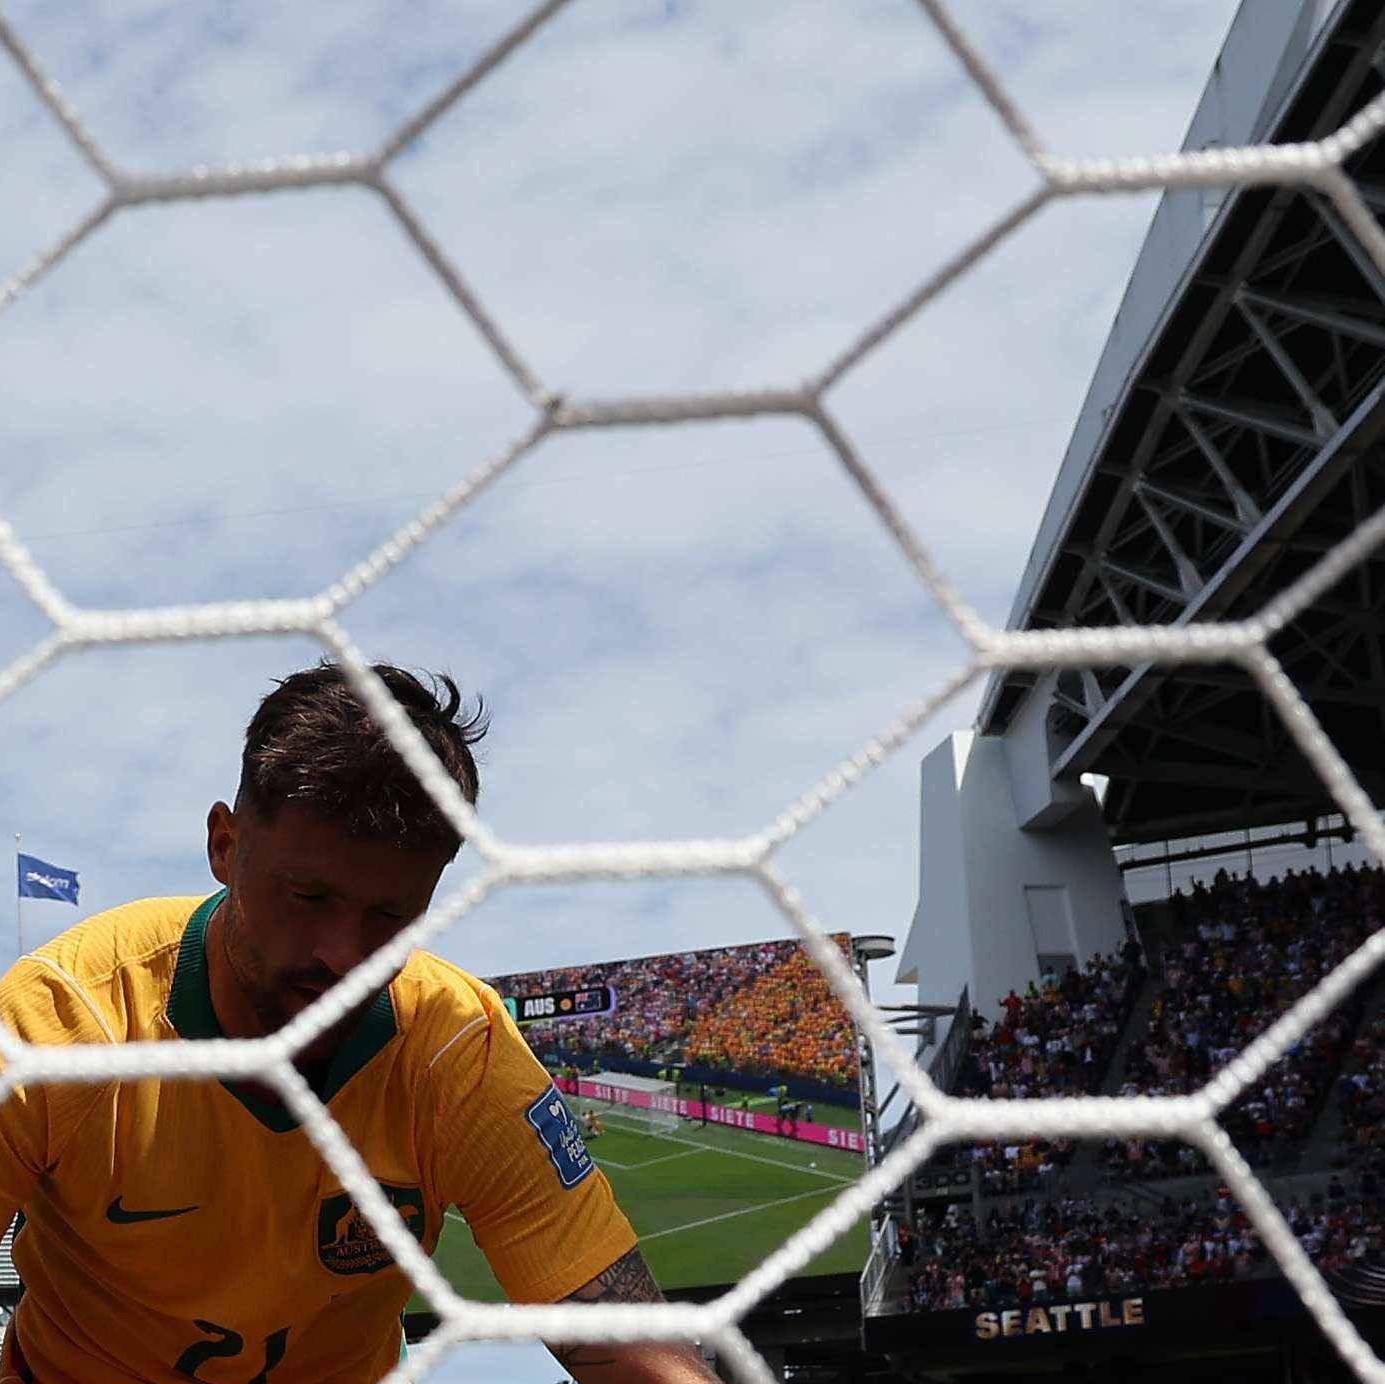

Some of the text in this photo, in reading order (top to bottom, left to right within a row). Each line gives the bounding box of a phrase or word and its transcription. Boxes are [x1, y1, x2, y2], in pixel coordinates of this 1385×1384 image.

[524, 997, 556, 1017] AUS
[710, 1106, 756, 1129] SIETE
[828, 1129, 859, 1150] SIE
[974, 1297, 1145, 1340] SEATTLE
